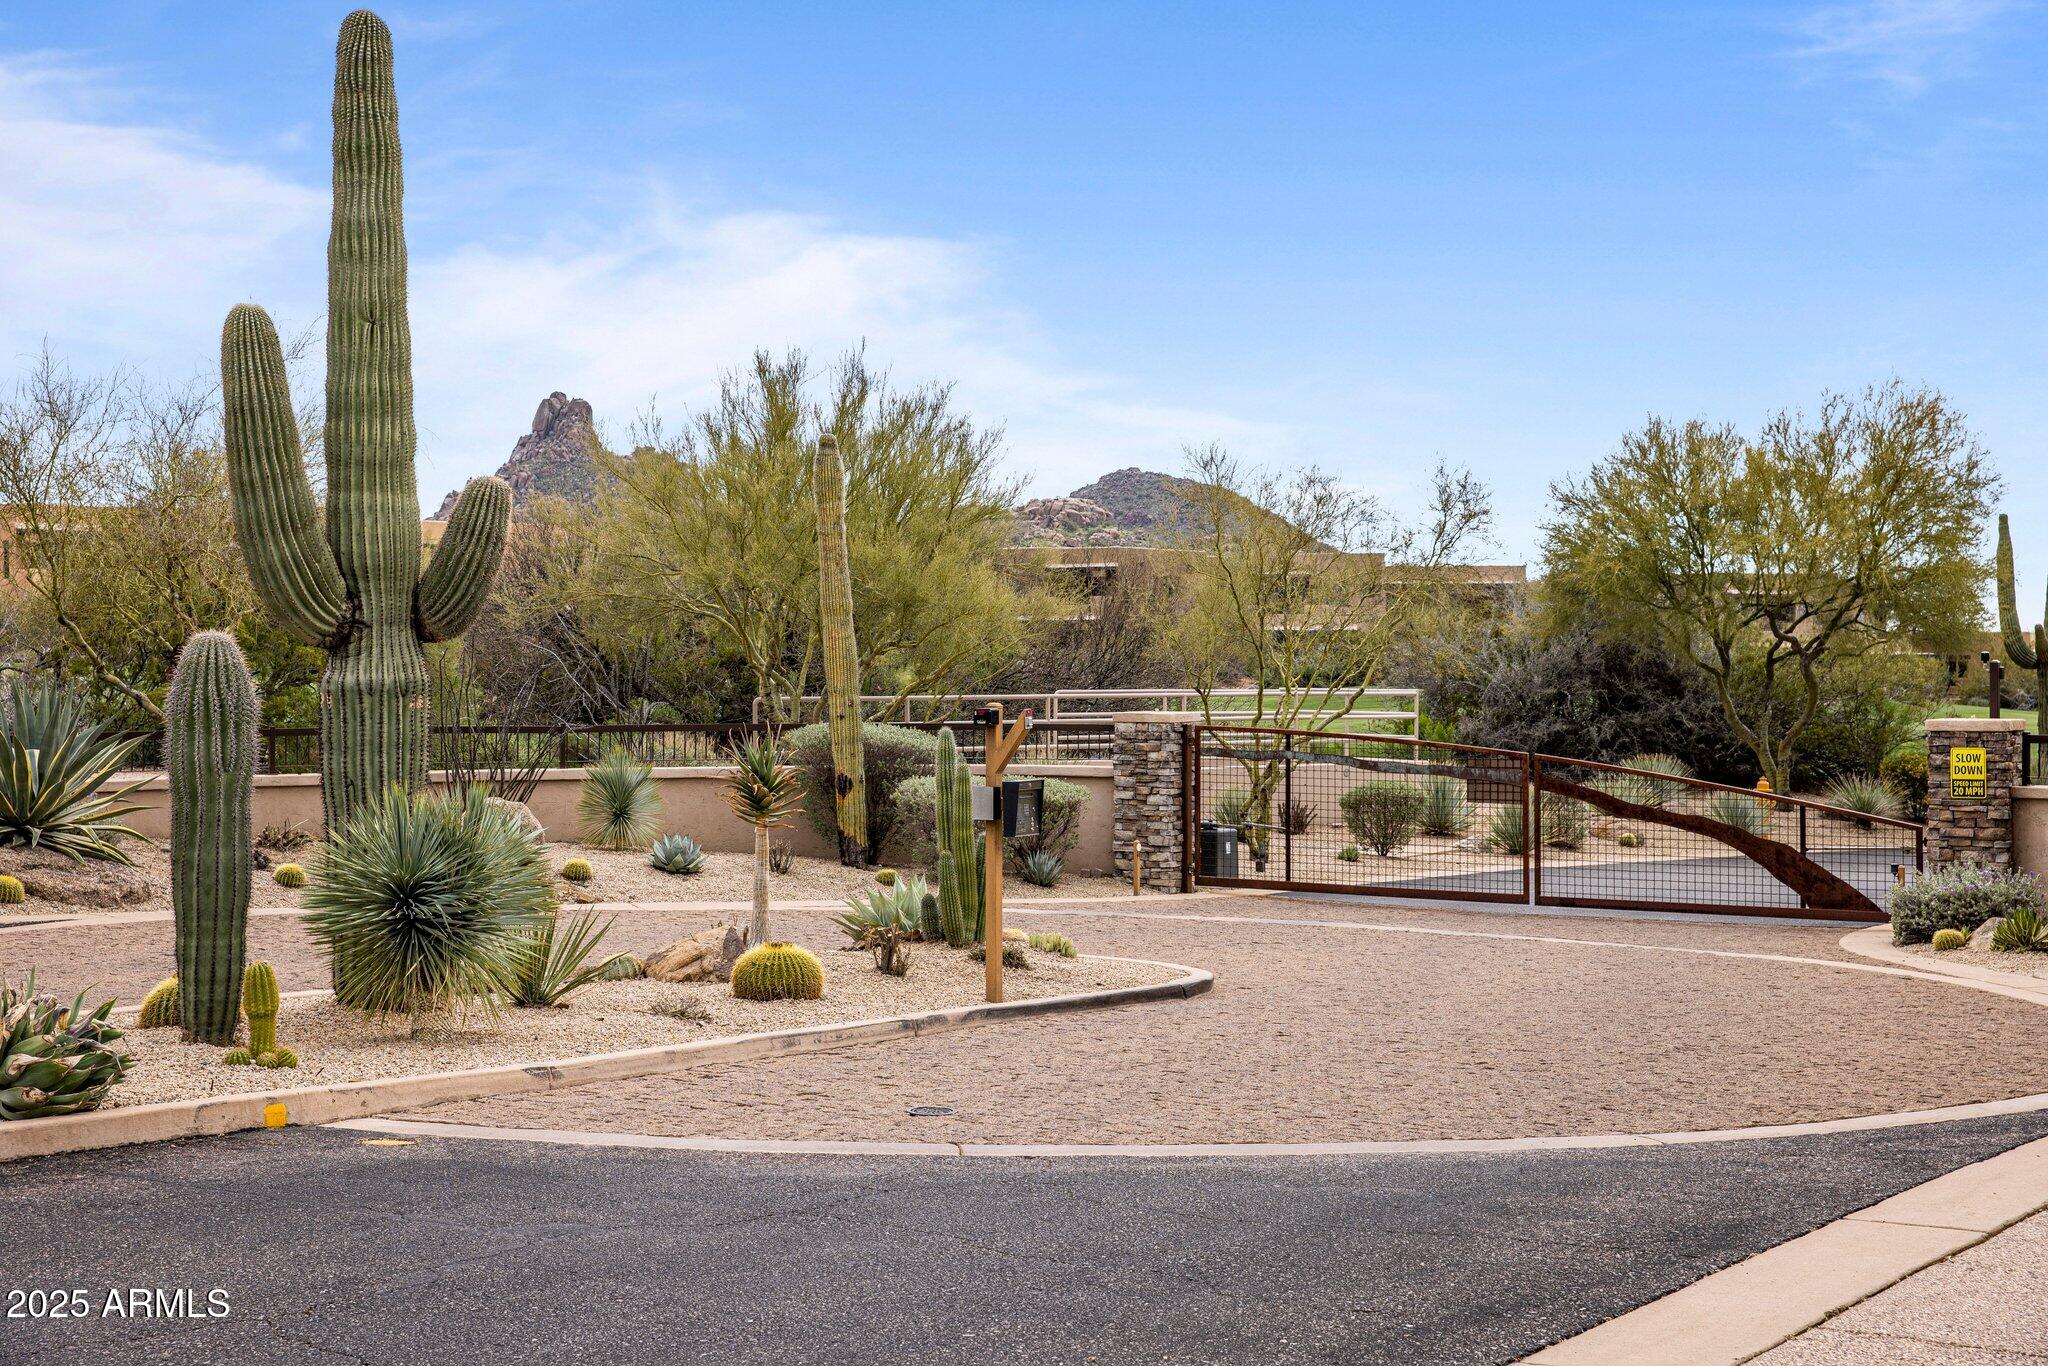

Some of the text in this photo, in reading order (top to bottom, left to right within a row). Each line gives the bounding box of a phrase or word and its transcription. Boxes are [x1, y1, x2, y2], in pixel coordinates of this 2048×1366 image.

[1956, 754, 1981, 762] SLOW
[1954, 766, 1982, 774] DOWN
[1954, 788, 1984, 796] 20 MPH
